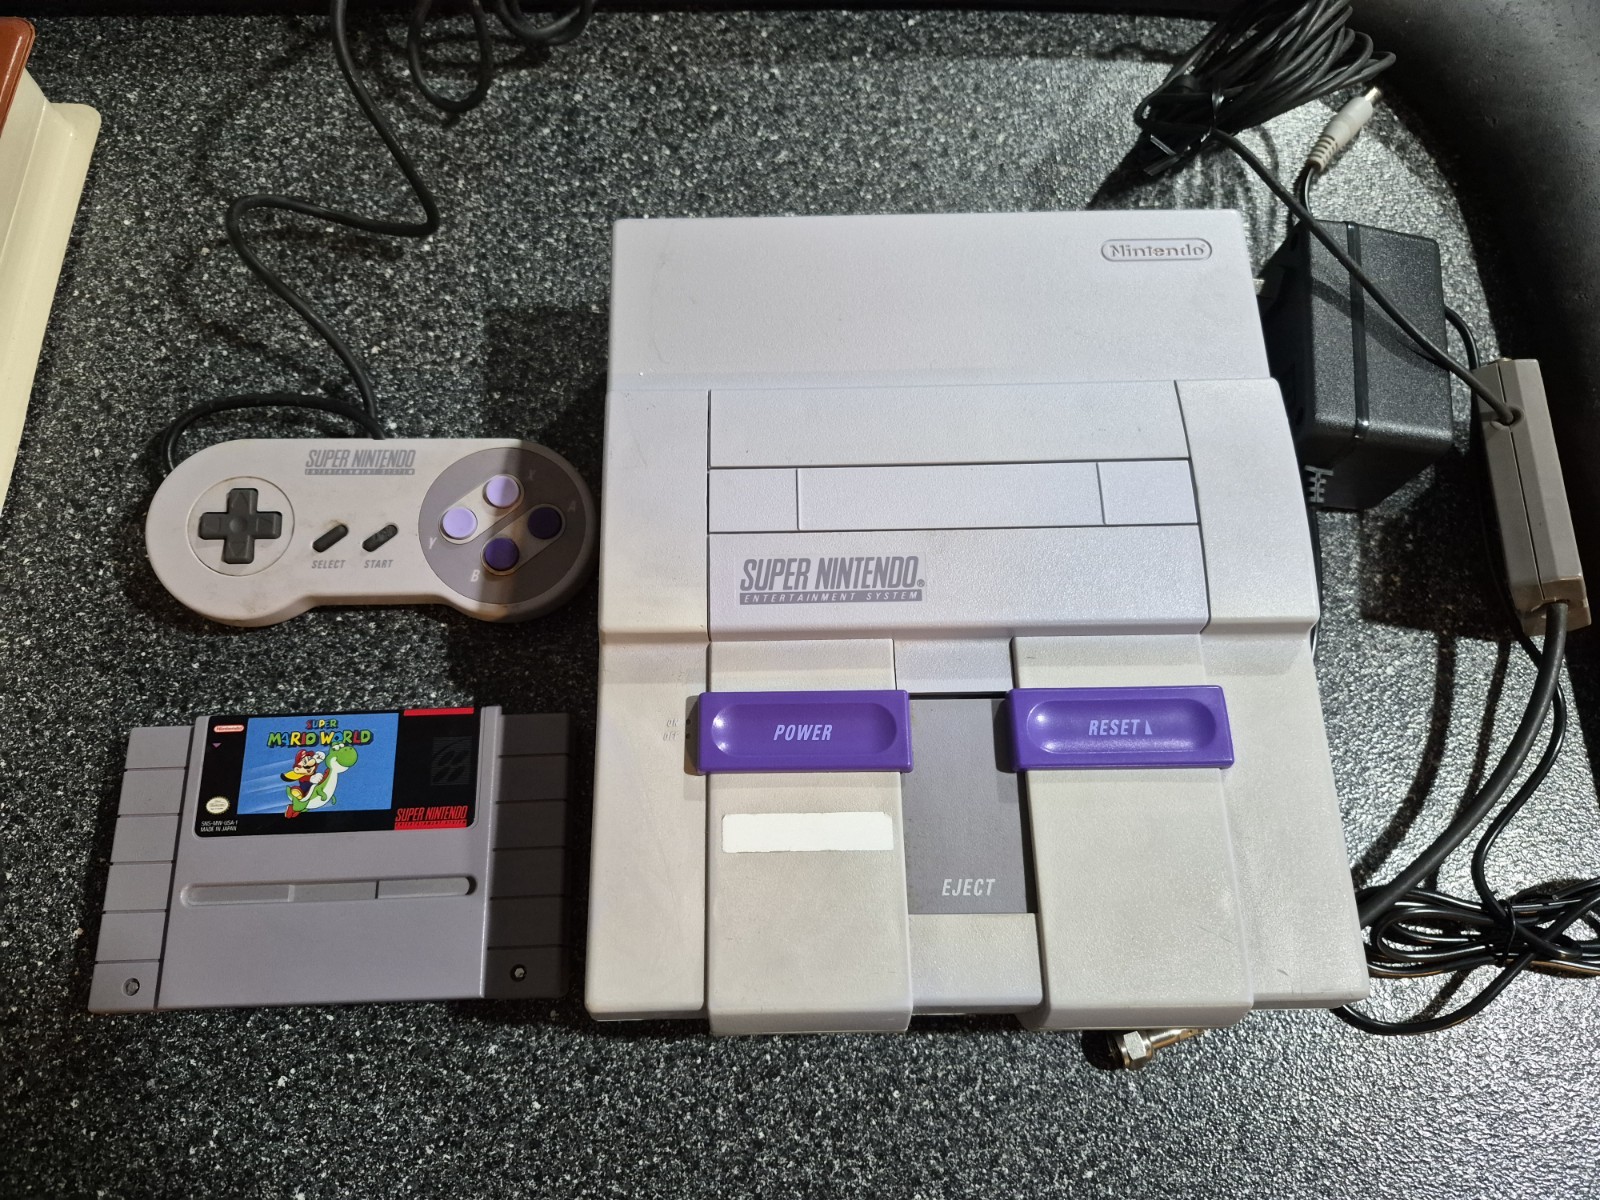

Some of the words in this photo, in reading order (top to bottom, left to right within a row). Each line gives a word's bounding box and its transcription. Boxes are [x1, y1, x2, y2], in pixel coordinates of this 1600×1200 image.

[1109, 243, 1205, 257] Nintendo
[305, 449, 351, 468] SUPER
[351, 449, 416, 468] NINTENDO
[428, 537, 437, 549] Y
[311, 559, 346, 569] SELECT
[364, 559, 394, 569] START
[470, 569, 480, 582] B
[740, 558, 811, 591] SUPER
[744, 593, 857, 603] ENTERTAINMENT
[866, 591, 918, 601] SYSTEM
[305, 719, 338, 730] SUPER
[773, 724, 833, 741] POWER
[1088, 718, 1140, 736] RESET
[267, 731, 320, 748] MARIO
[320, 729, 373, 746] WORLD
[395, 807, 425, 821] SUPER
[425, 805, 468, 820] NINTENDO
[942, 878, 996, 896] EJECT
